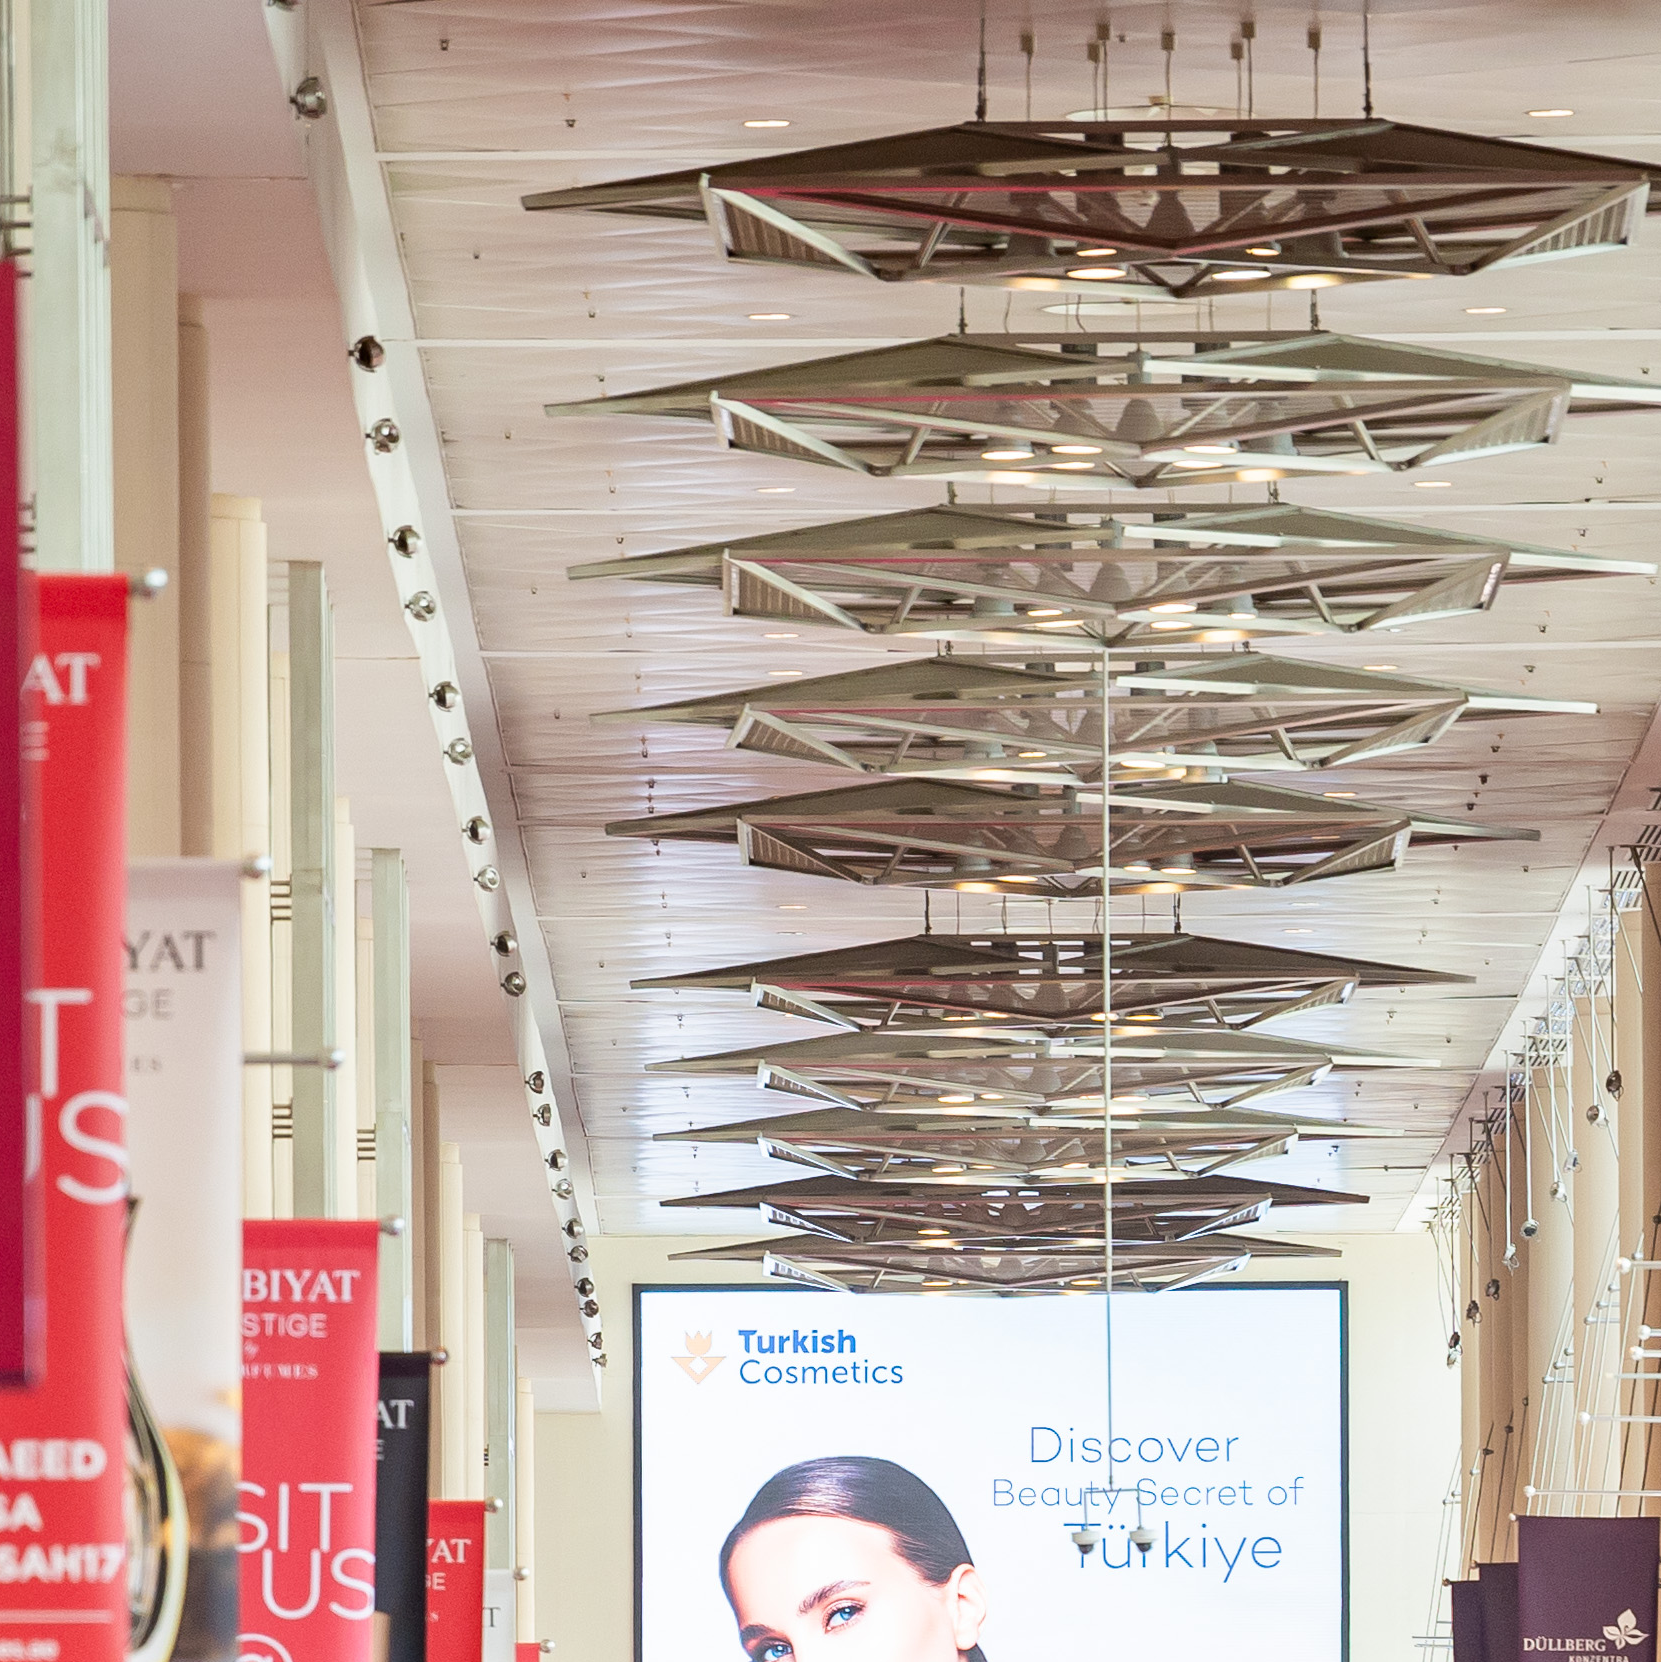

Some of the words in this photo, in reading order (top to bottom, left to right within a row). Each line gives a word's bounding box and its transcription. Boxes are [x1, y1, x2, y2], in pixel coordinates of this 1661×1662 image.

[738, 1329, 857, 1355] Turkish
[738, 1359, 905, 1387] Cosmetics
[1030, 1425, 1239, 1464] Discover
[993, 1479, 1122, 1513] Beauty
[1136, 1477, 1254, 1507] Secret
[1266, 1476, 1305, 1508] of
[1063, 1520, 1283, 1583] Türkiye
[1523, 1636, 1607, 1652] DÜLLBERG
